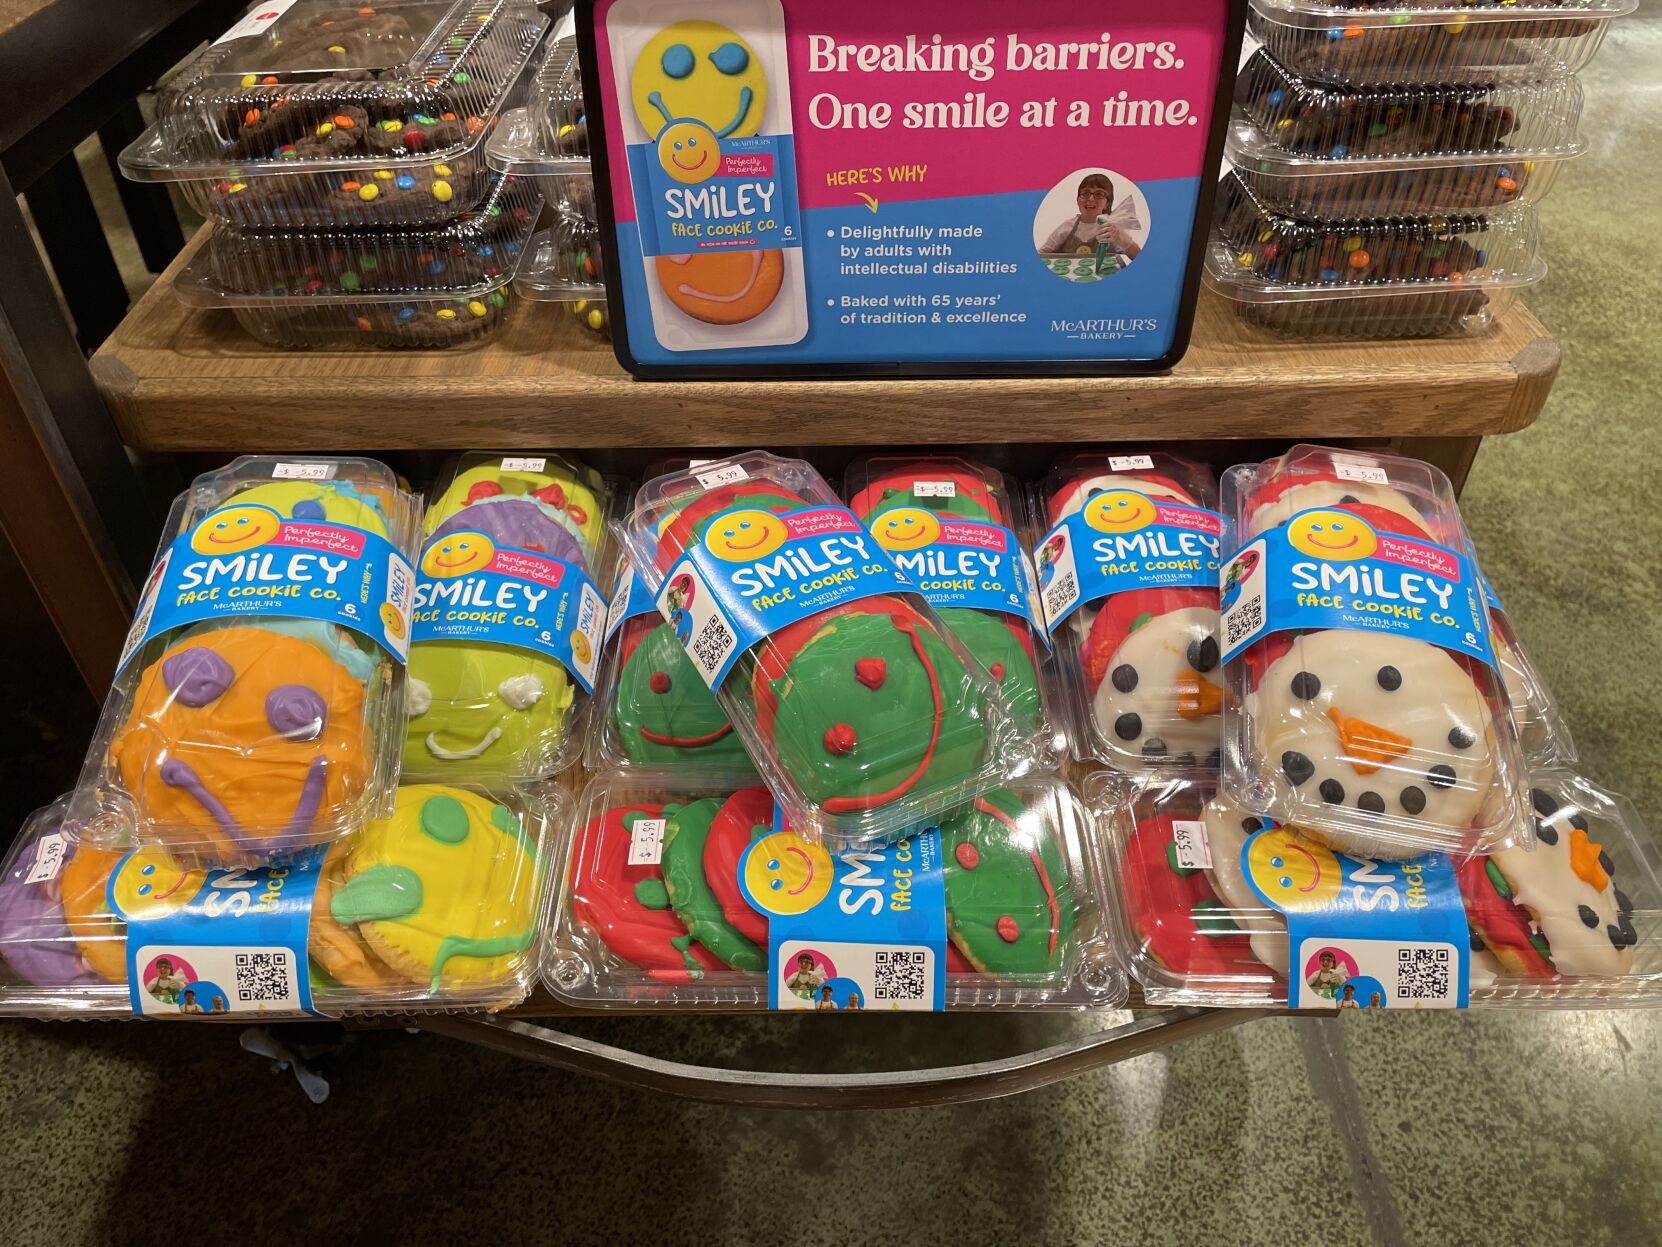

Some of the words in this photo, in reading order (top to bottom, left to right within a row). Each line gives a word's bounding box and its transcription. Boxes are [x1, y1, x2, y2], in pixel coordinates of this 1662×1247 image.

[808, 33, 995, 82] Breaking
[1006, 32, 1184, 71] barriers.
[808, 93, 892, 130] One
[902, 92, 1009, 129] smile
[1020, 96, 1057, 128] at
[1066, 99, 1090, 128] a
[1103, 90, 1198, 127] time.
[725, 156, 761, 167] Perfectly
[727, 164, 768, 174] Imperfect
[826, 167, 882, 187] HERE'S
[888, 164, 928, 182] WHY
[671, 222, 702, 238] FACE
[757, 219, 778, 233] CO.
[784, 225, 792, 237] 6
[840, 225, 933, 240] Delightfully
[938, 226, 983, 238] made
[840, 244, 860, 259] by
[864, 244, 913, 257] adults
[917, 244, 952, 256] with
[840, 262, 927, 275] intellectual
[932, 261, 1017, 275] disabilities
[841, 295, 889, 307] Baked
[893, 295, 926, 307] with
[931, 295, 951, 306] 65
[955, 293, 1001, 309] years'
[840, 311, 858, 324] of
[860, 312, 926, 324] tradition
[931, 312, 942, 323] &
[946, 311, 1027, 323] excellence
[1050, 318, 1157, 333] McARTHUR'S
[1080, 332, 1123, 340] BAKERY
[716, 470, 738, 481] 5.99
[787, 513, 842, 527] Perfectly
[1159, 507, 1210, 523] Perfectly
[284, 526, 350, 544] Perfectly
[795, 519, 856, 535] Imperfect
[944, 525, 995, 539] Perfectly
[283, 534, 358, 553] Imperfect
[946, 533, 1004, 548] Imperfect
[1382, 540, 1445, 563] Perfectly
[496, 552, 552, 574] Perfectly
[896, 551, 1001, 578] MiLEY
[1100, 559, 1140, 576] FACE
[1385, 549, 1456, 576] Imperfect
[496, 562, 558, 582] Imperfect
[893, 570, 905, 581] 6
[1139, 573, 1193, 582] McARTHUR'S
[751, 589, 796, 612] FACE
[861, 563, 888, 578] CO.
[981, 580, 1006, 592] CO.
[176, 587, 221, 607] FACE
[310, 587, 342, 601] CO.
[799, 585, 856, 609] McARTHUR'S
[924, 593, 966, 601] ARTHUR'S
[1009, 593, 1019, 603] 6
[213, 600, 282, 611] McARTHUR'S
[344, 603, 356, 614] 6
[1297, 592, 1344, 607] FACE
[1430, 612, 1461, 630] CO.
[413, 609, 440, 623] ACE
[513, 615, 540, 629] CO.
[1342, 614, 1410, 631] McARTHUR'S
[432, 625, 490, 634] McARTHUR'S
[540, 630, 552, 641] 6
[1465, 632, 1477, 644] 6
[640, 821, 656, 843] 5.99
[1176, 829, 1193, 850] 5.99
[43, 842, 61, 865] 5.99
[889, 868, 913, 912] FACE
[1401, 864, 1429, 908] FACE
